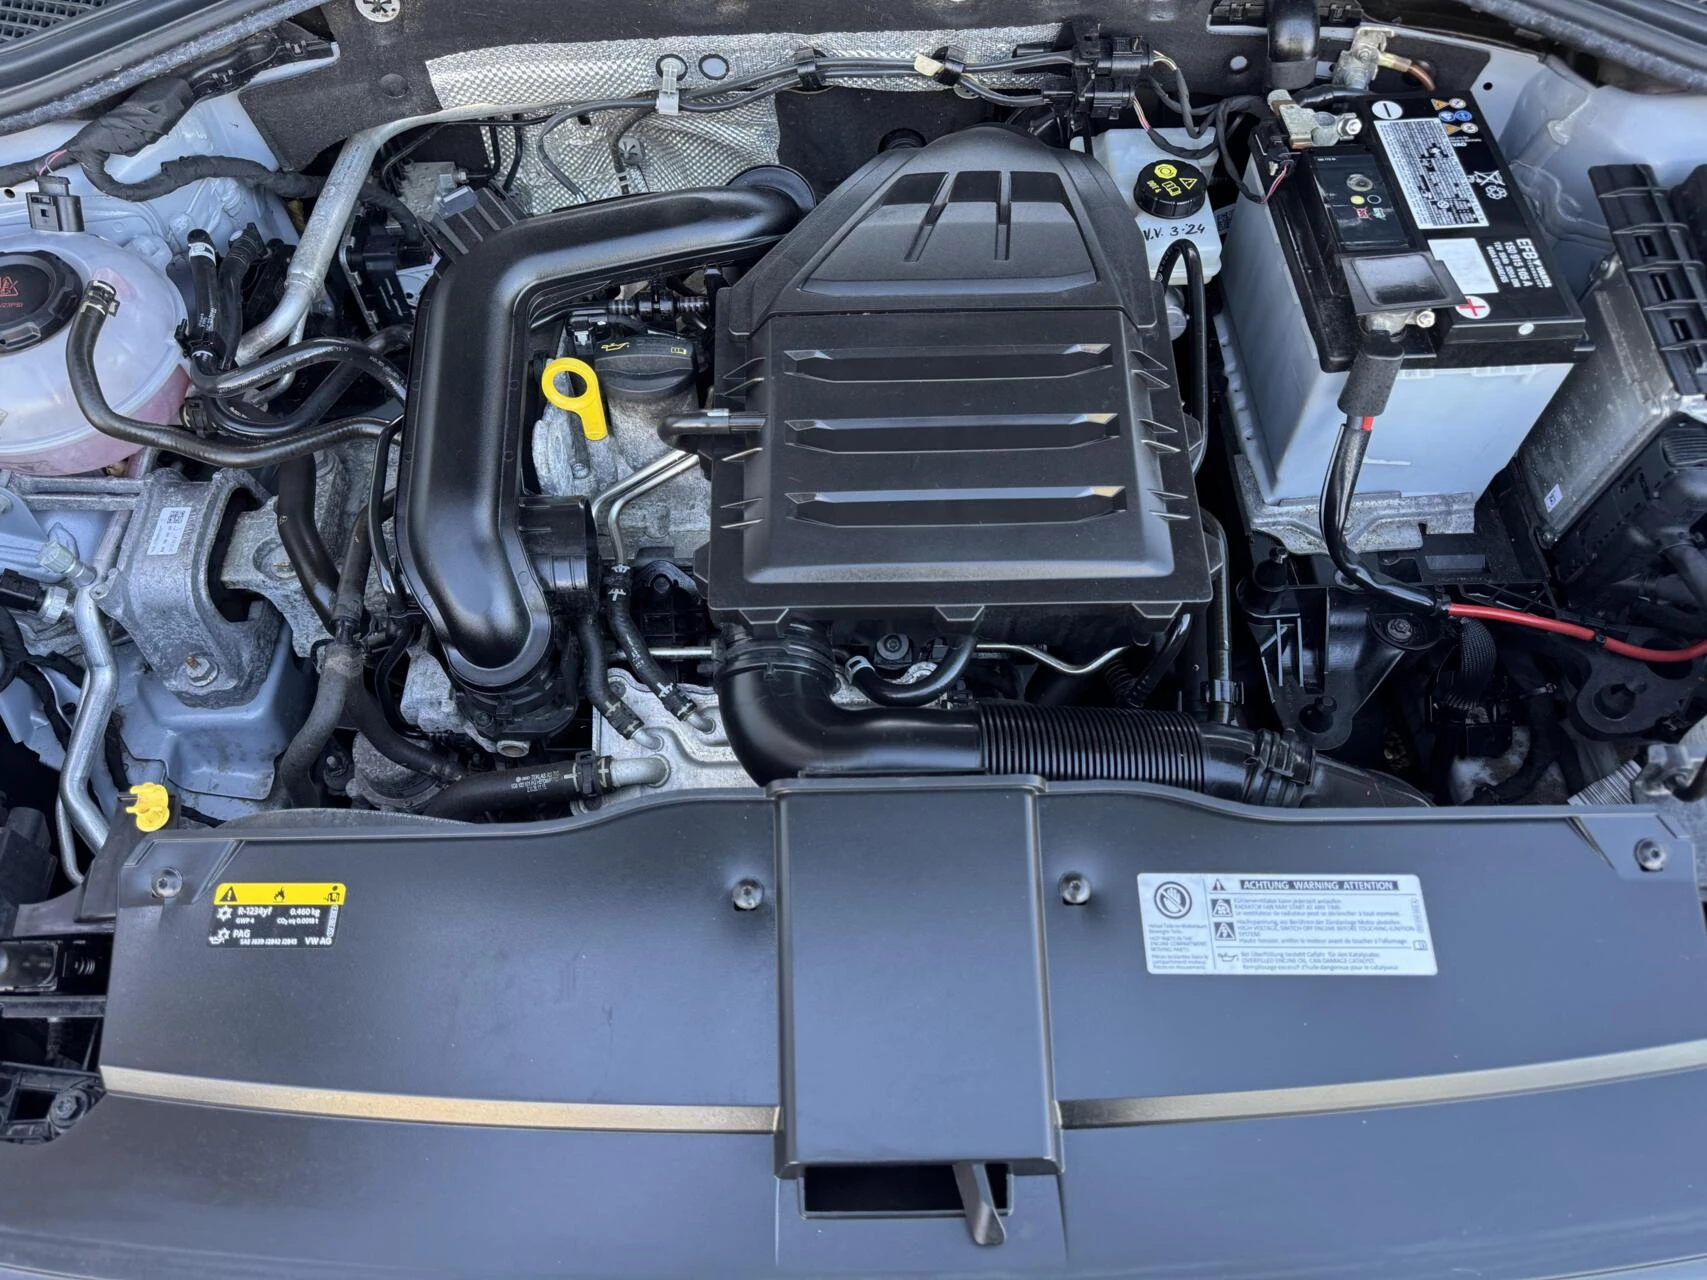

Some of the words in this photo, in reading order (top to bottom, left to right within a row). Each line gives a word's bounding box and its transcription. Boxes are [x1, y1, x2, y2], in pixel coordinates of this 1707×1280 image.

[1515, 237, 1539, 260] EFB
[1510, 253, 1524, 267] 915
[1243, 880, 1289, 890] ACHTUNG
[1293, 880, 1339, 890] WARNING
[1343, 880, 1393, 890] ATTENTION
[237, 906, 273, 918] R-1234yf
[311, 907, 320, 918] kg
[232, 929, 251, 939] PAG
[305, 937, 319, 946] VW
[319, 937, 333, 946] AG
